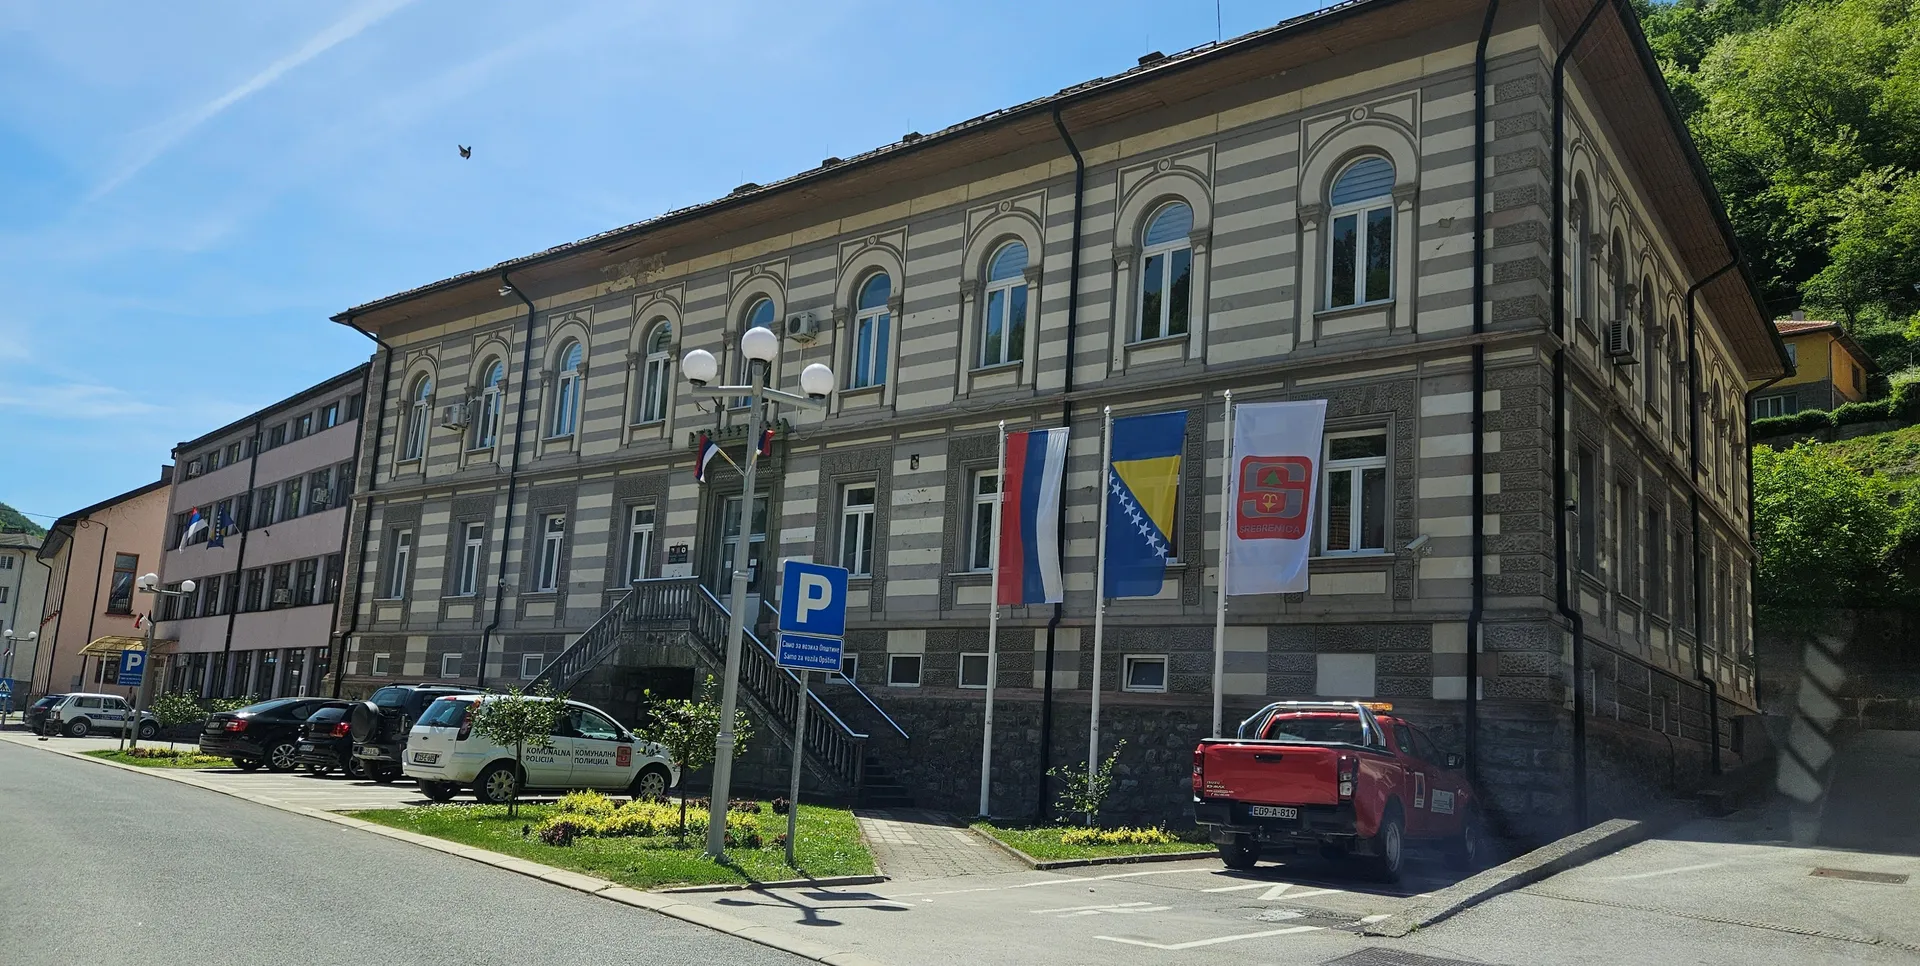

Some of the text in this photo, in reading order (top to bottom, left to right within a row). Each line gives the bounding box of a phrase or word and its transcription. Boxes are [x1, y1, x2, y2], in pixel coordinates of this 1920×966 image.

[1240, 524, 1300, 534] SREBRENICA
[796, 573, 832, 623] P
[782, 640, 795, 648] Само
[819, 644, 840, 653] Општине
[126, 653, 142, 671] P
[784, 652, 797, 660] Samo
[819, 656, 836, 664] Opštine
[526, 747, 570, 756] KOMUNALNA
[574, 750, 616, 758] КОМУНАЛНА
[526, 755, 554, 763] POLICIJA
[1254, 807, 1296, 818] E09-A-819
